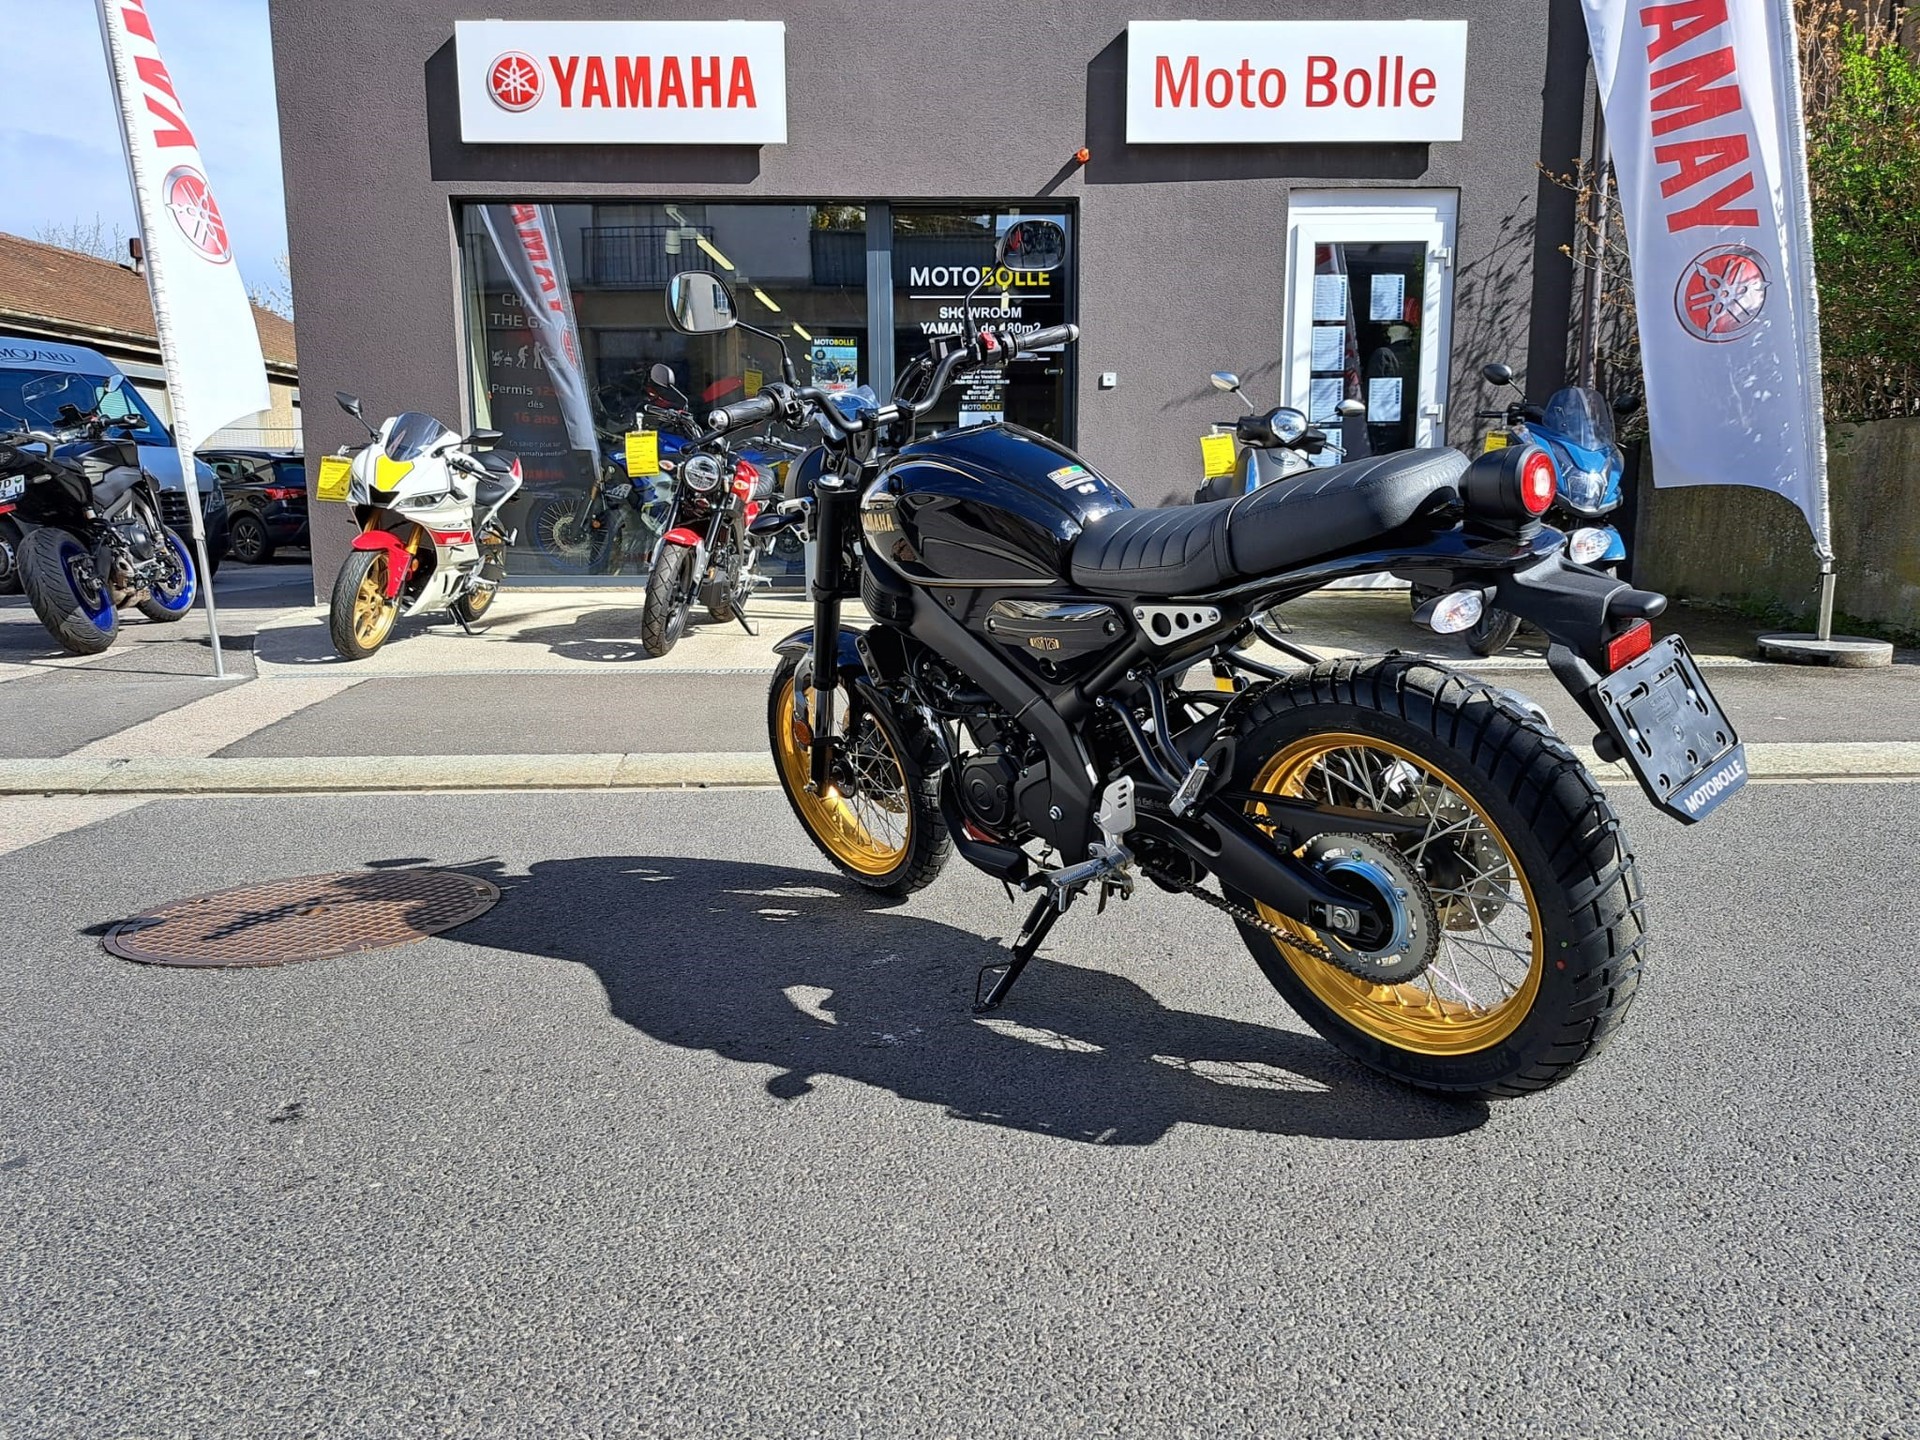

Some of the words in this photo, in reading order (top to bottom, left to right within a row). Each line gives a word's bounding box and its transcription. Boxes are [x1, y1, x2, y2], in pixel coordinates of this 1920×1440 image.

[548, 56, 757, 108] YAMAHA
[1154, 55, 1287, 109] Moto
[1305, 55, 1437, 109] Bolle
[910, 266, 1050, 287] MOTOBOLLE
[939, 306, 1022, 319] SHOWROOM
[491, 313, 522, 327] THE
[920, 322, 977, 335] YAMAH
[980, 322, 996, 334] de
[814, 338, 855, 346] MOTOBOLLE
[491, 383, 533, 396] Permis
[961, 403, 1001, 411] MOTOBOLLE
[514, 411, 531, 423] 16
[534, 413, 560, 425] ans
[1683, 759, 1745, 813] MOTOBOLLE
